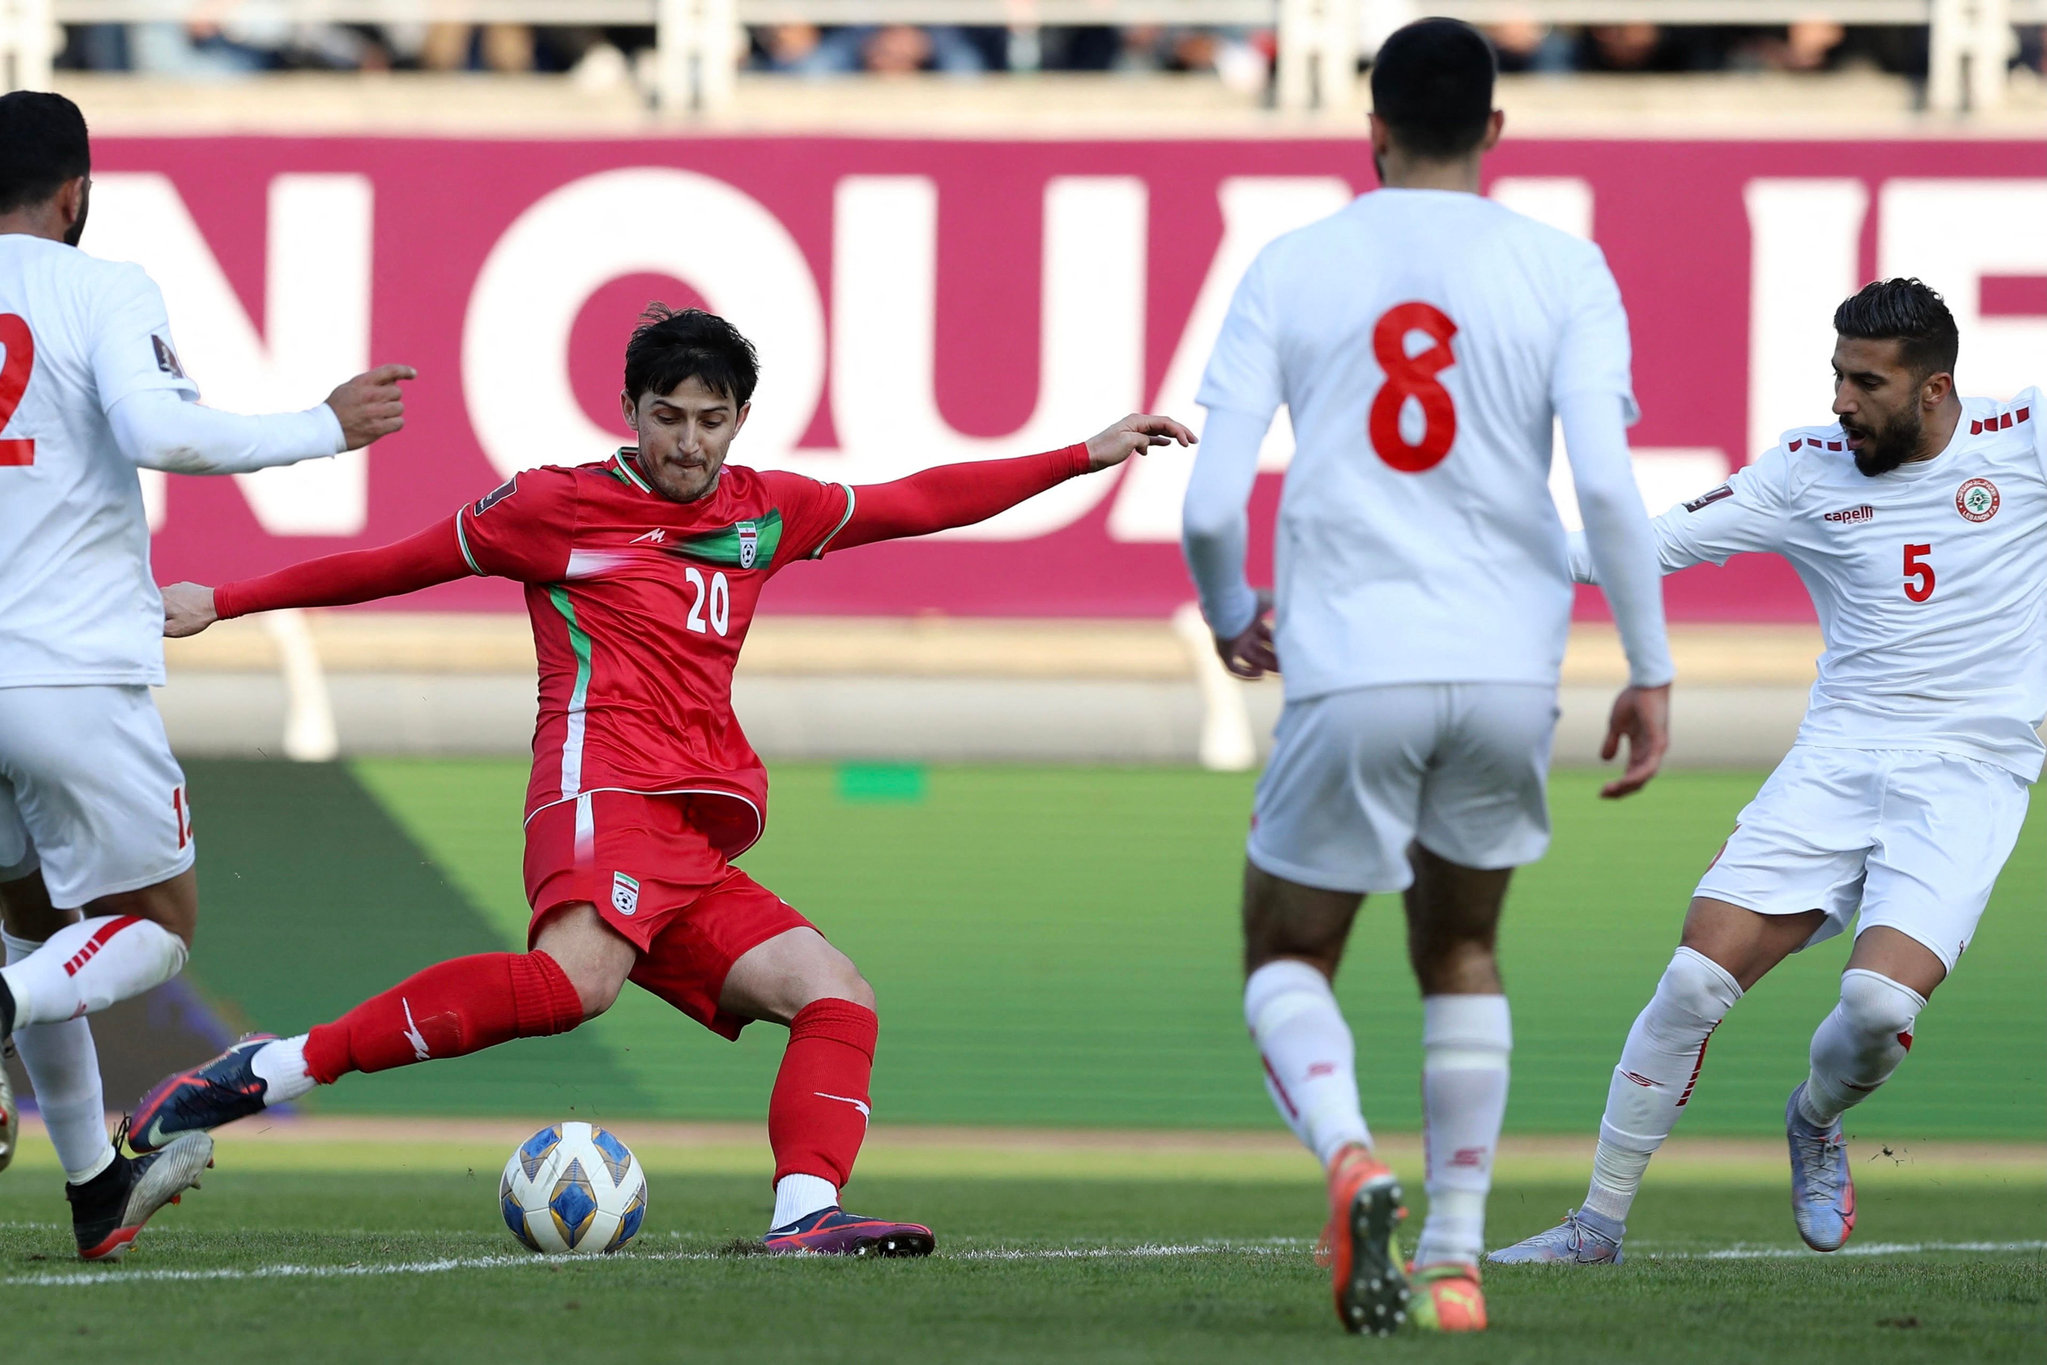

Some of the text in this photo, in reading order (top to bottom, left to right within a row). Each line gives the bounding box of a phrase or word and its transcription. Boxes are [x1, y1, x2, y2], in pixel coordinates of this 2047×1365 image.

[1369, 302, 1458, 473] 8
[1823, 505, 1873, 524] capelli
[685, 567, 729, 637] 20
[1903, 543, 1936, 603] 5
[173, 786, 193, 850] 1
